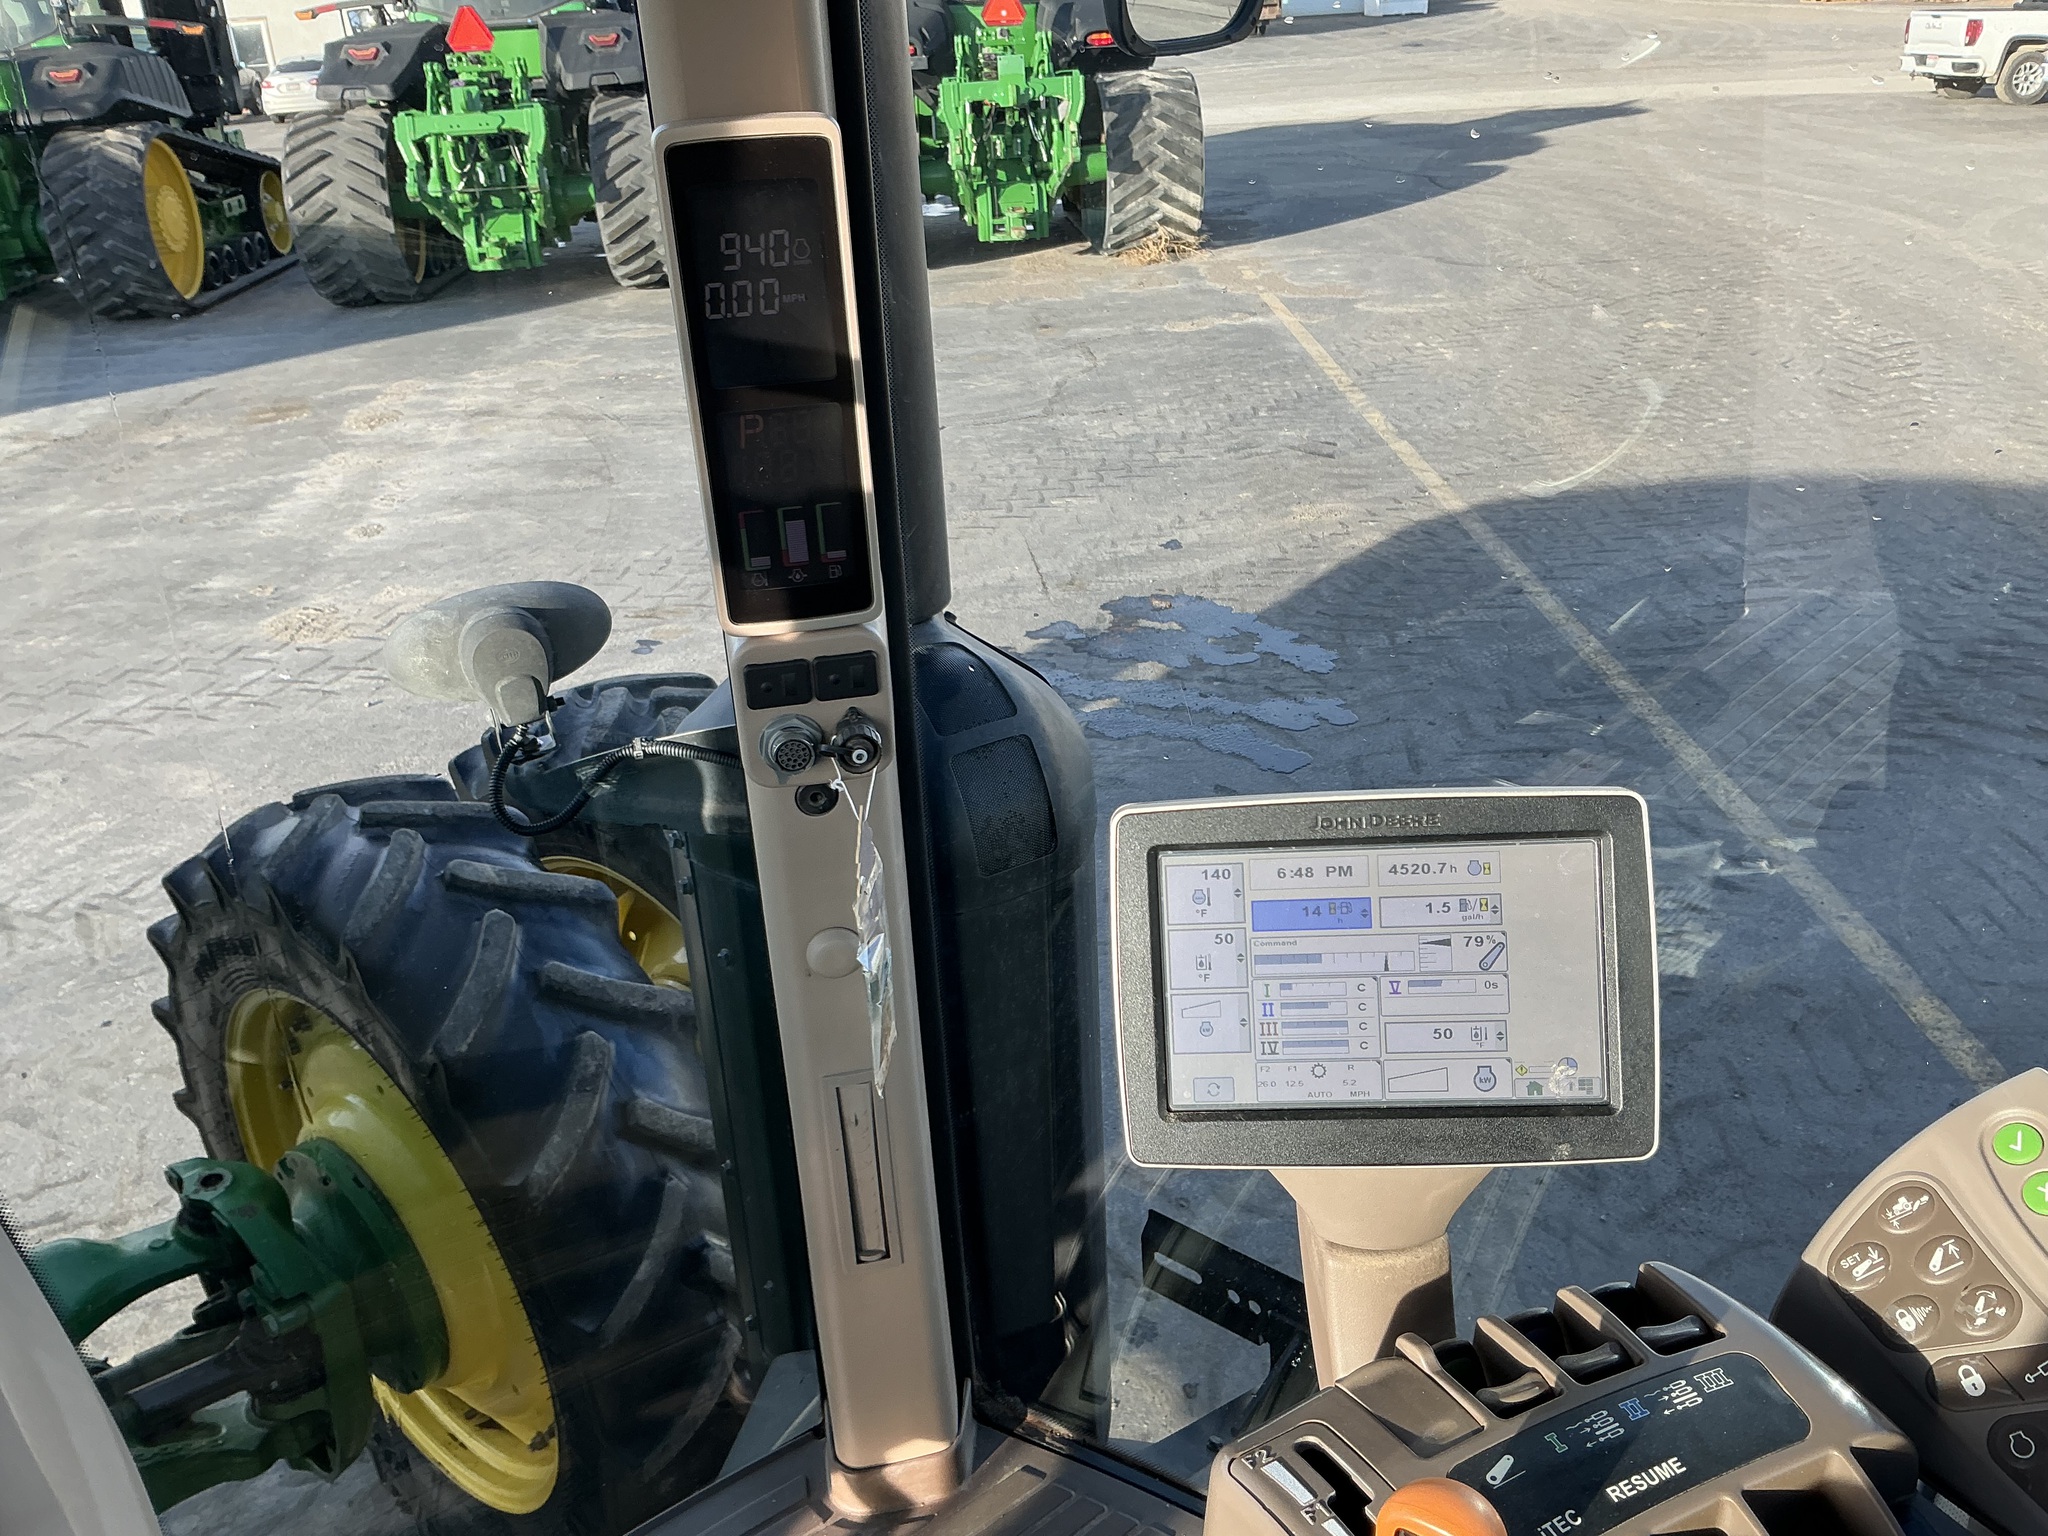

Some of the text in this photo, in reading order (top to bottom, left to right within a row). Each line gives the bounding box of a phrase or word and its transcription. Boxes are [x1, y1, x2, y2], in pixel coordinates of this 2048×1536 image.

[720, 229, 790, 271] 940
[705, 278, 806, 319] 0.00 MPH
[1314, 813, 1441, 831] JOHN DEERE
[1201, 868, 1232, 881] 140
[1277, 865, 1353, 879] 6:48 PM
[1302, 905, 1322, 917] 14
[1425, 901, 1451, 914] 1.5
[1461, 914, 1484, 922] gal/h
[1214, 933, 1234, 945] 50
[1357, 983, 1366, 992] C
[1358, 1003, 1367, 1011] C
[1359, 1022, 1368, 1030] C
[1432, 1028, 1453, 1040] 50
[1360, 1041, 1369, 1050] C
[1260, 1065, 1271, 1073] F2
[1478, 1076, 1492, 1084] kW
[1350, 1090, 1370, 1098] MPH
[1840, 1252, 1861, 1269] SET
[1241, 1449, 1274, 1470] F2
[1605, 1456, 1687, 1503] RESUME
[1300, 1502, 1331, 1526] F1
